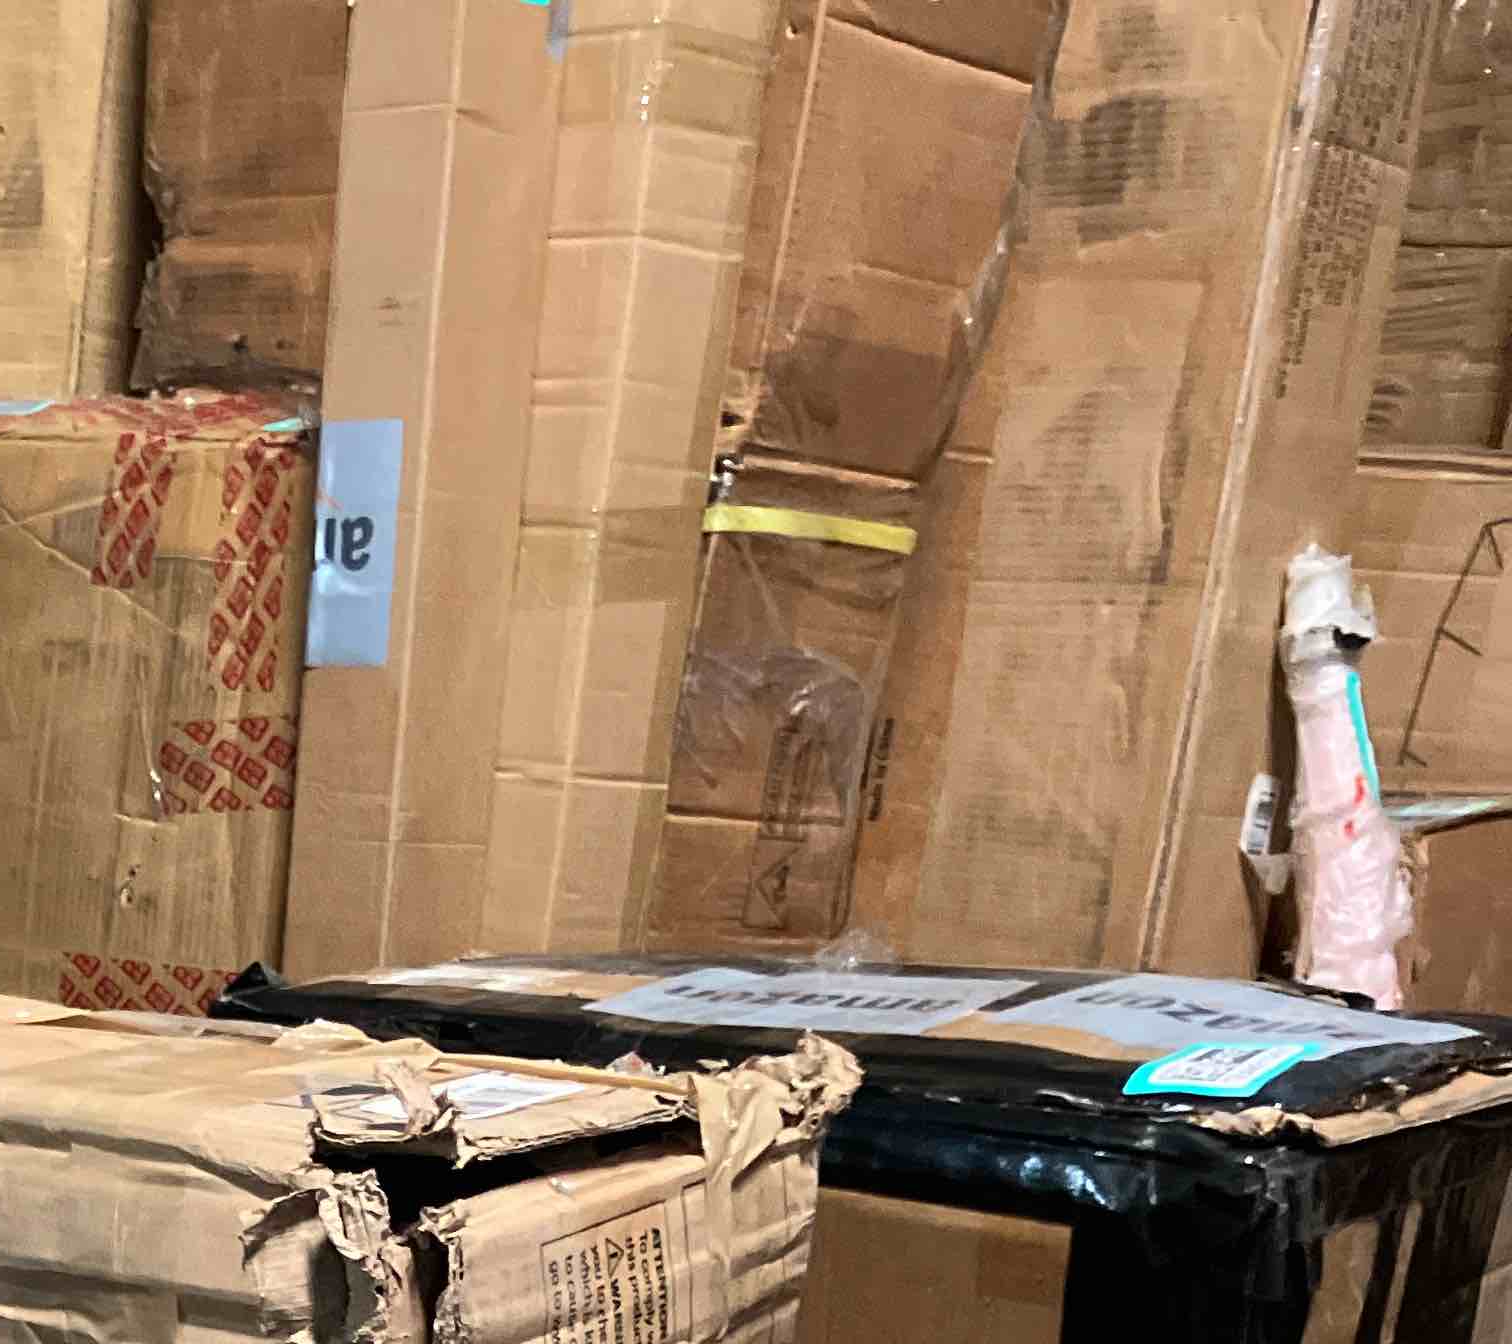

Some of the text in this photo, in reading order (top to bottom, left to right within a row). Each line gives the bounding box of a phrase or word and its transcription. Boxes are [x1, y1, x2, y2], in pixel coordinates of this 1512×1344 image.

[626, 1236, 635, 1270] this
[640, 1232, 647, 1253] To
[550, 1261, 559, 1285] go
[566, 1255, 574, 1274] to
[580, 1250, 594, 1308] which
[591, 1246, 602, 1280] you
[597, 1285, 606, 1304] to
[554, 1291, 562, 1310] to
[642, 1259, 655, 1325] comply
[652, 1228, 667, 1340] ATTENTION
